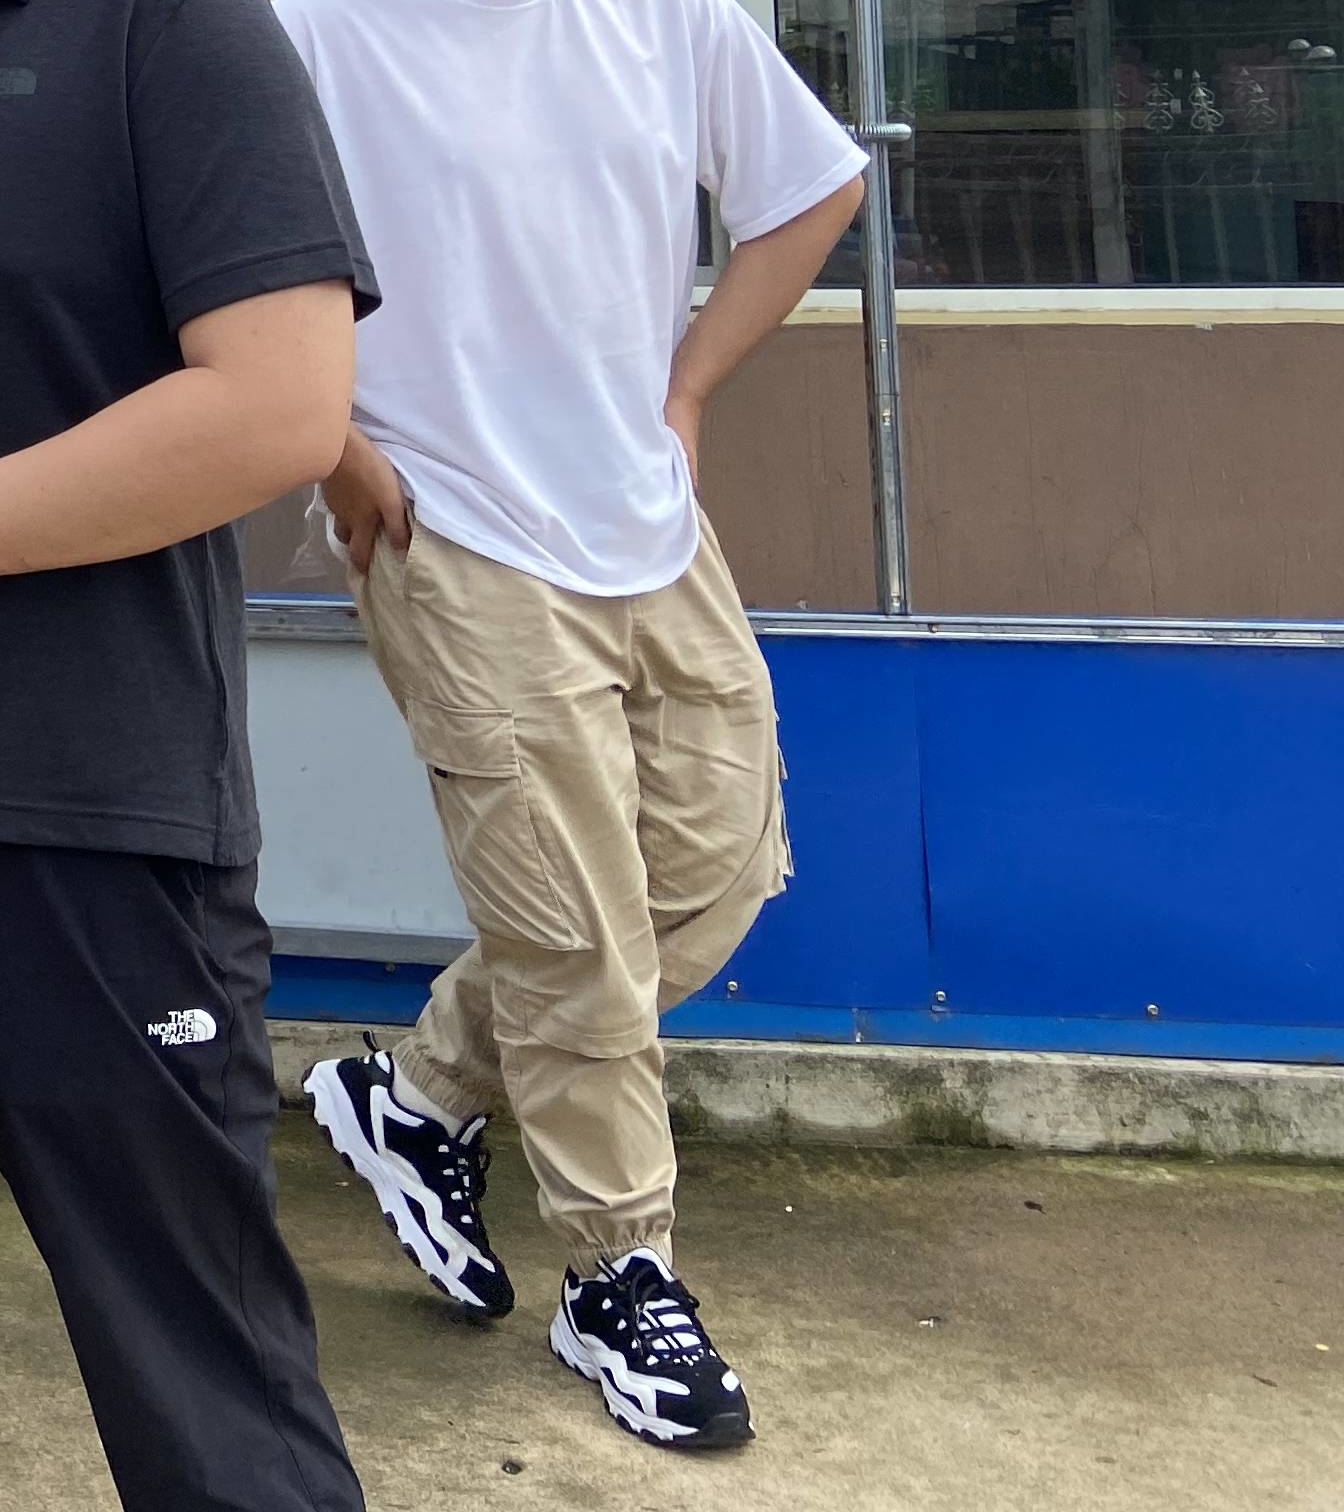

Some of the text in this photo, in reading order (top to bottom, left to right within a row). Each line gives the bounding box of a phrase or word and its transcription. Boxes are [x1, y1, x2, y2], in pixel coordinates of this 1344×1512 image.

[168, 1009, 195, 1023] THE
[147, 1021, 193, 1036] NORTH
[161, 1033, 194, 1045] FACE
